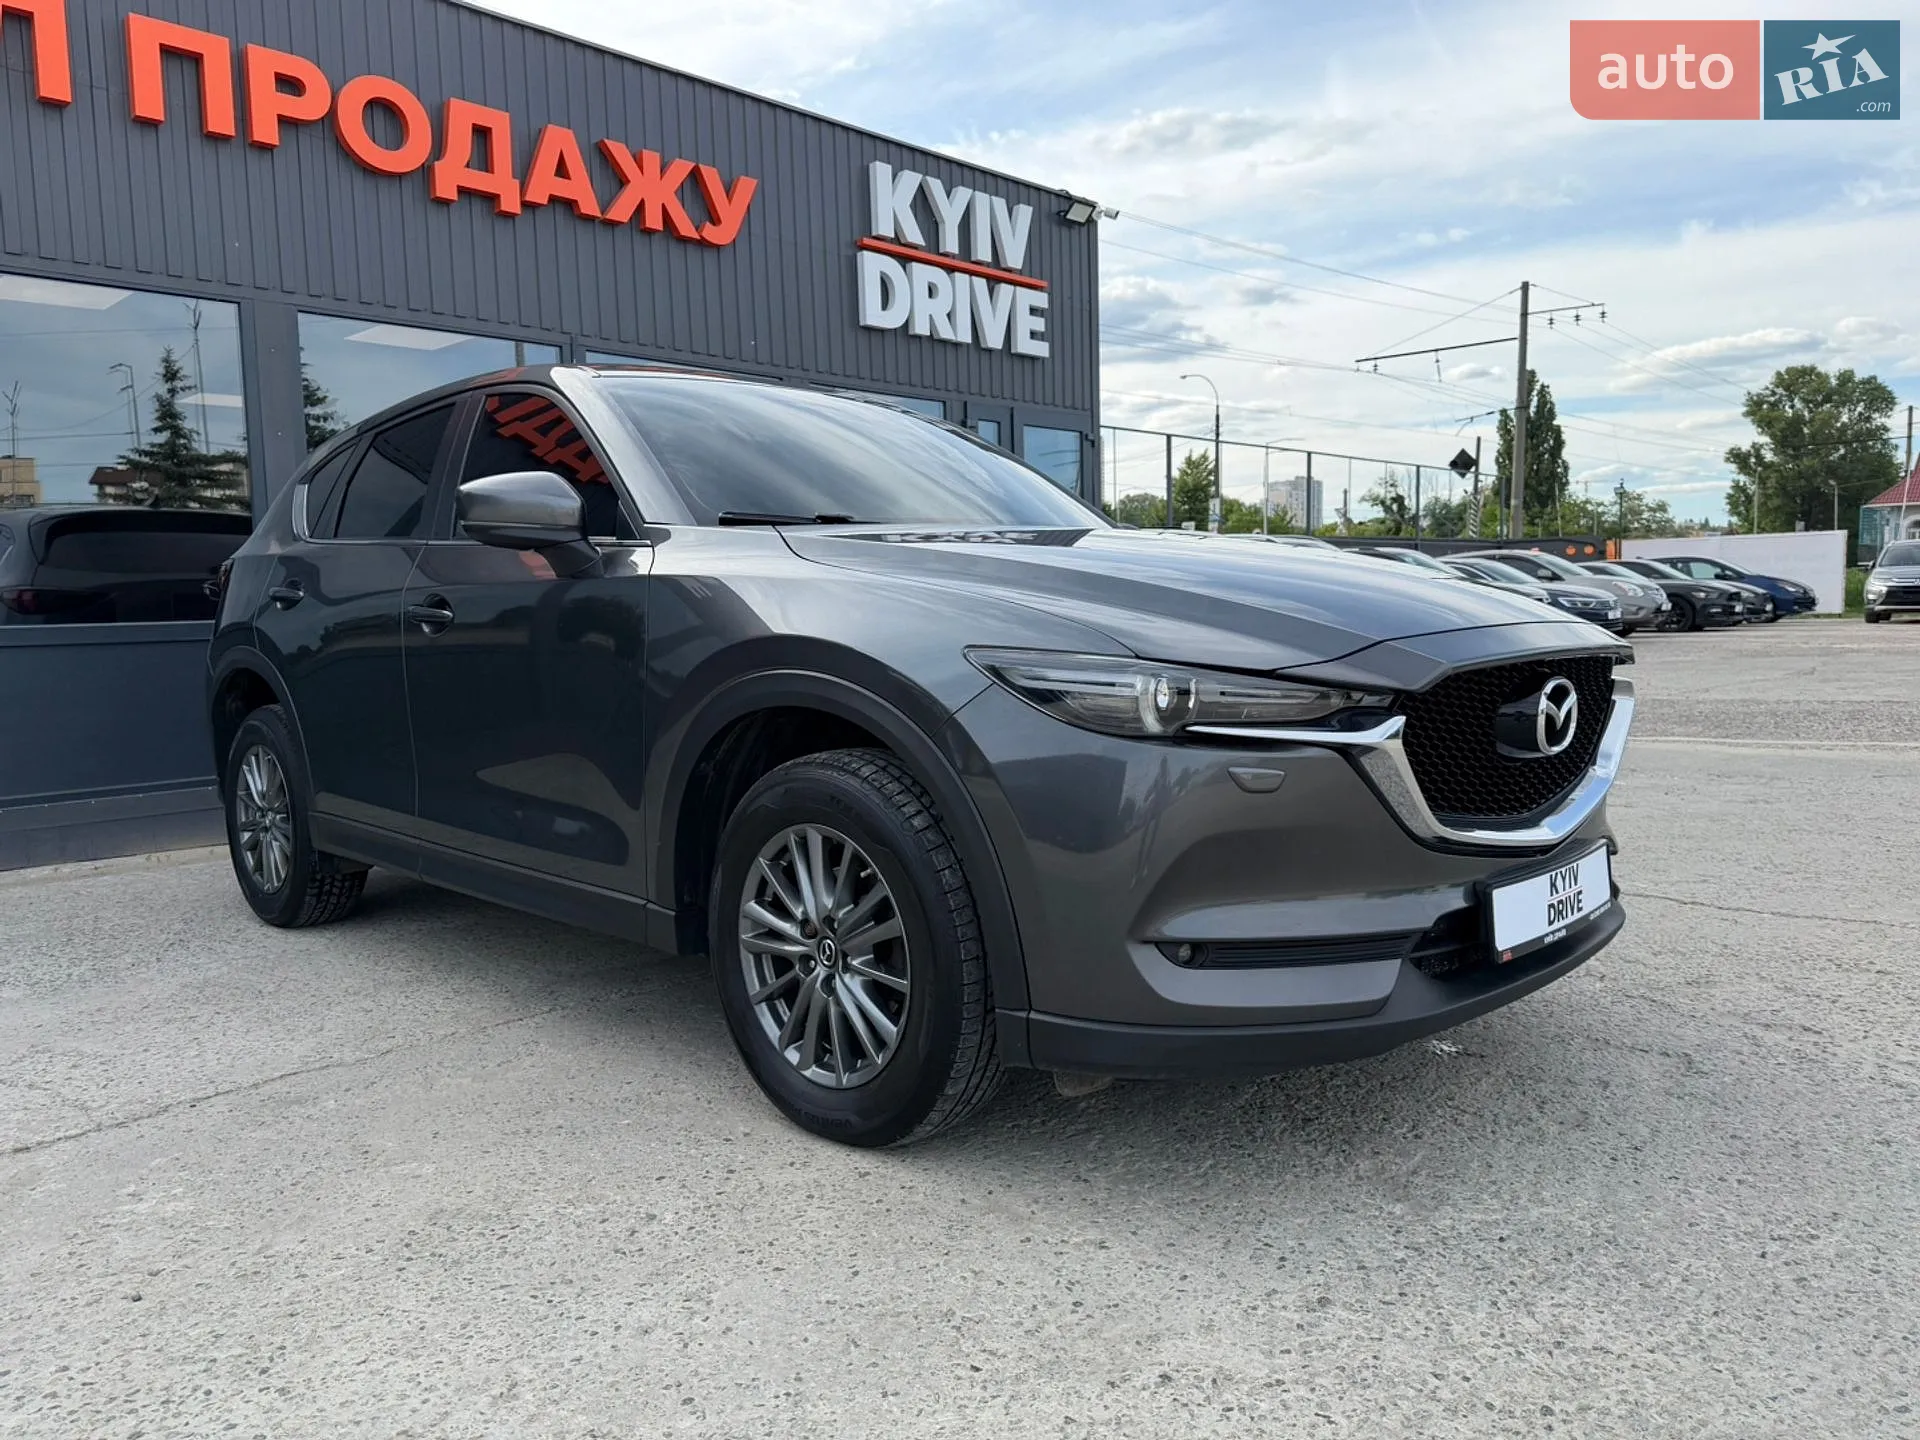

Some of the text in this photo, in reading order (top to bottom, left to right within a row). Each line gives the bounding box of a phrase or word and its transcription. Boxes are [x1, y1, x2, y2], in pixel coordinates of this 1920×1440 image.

[125, 12, 758, 246] ПРОДАЖУ
[869, 160, 1034, 272] KYIV
[857, 249, 1050, 358] DRIVE
[1547, 889, 1584, 927] DRIVE
[1549, 863, 1580, 897] KYIV
